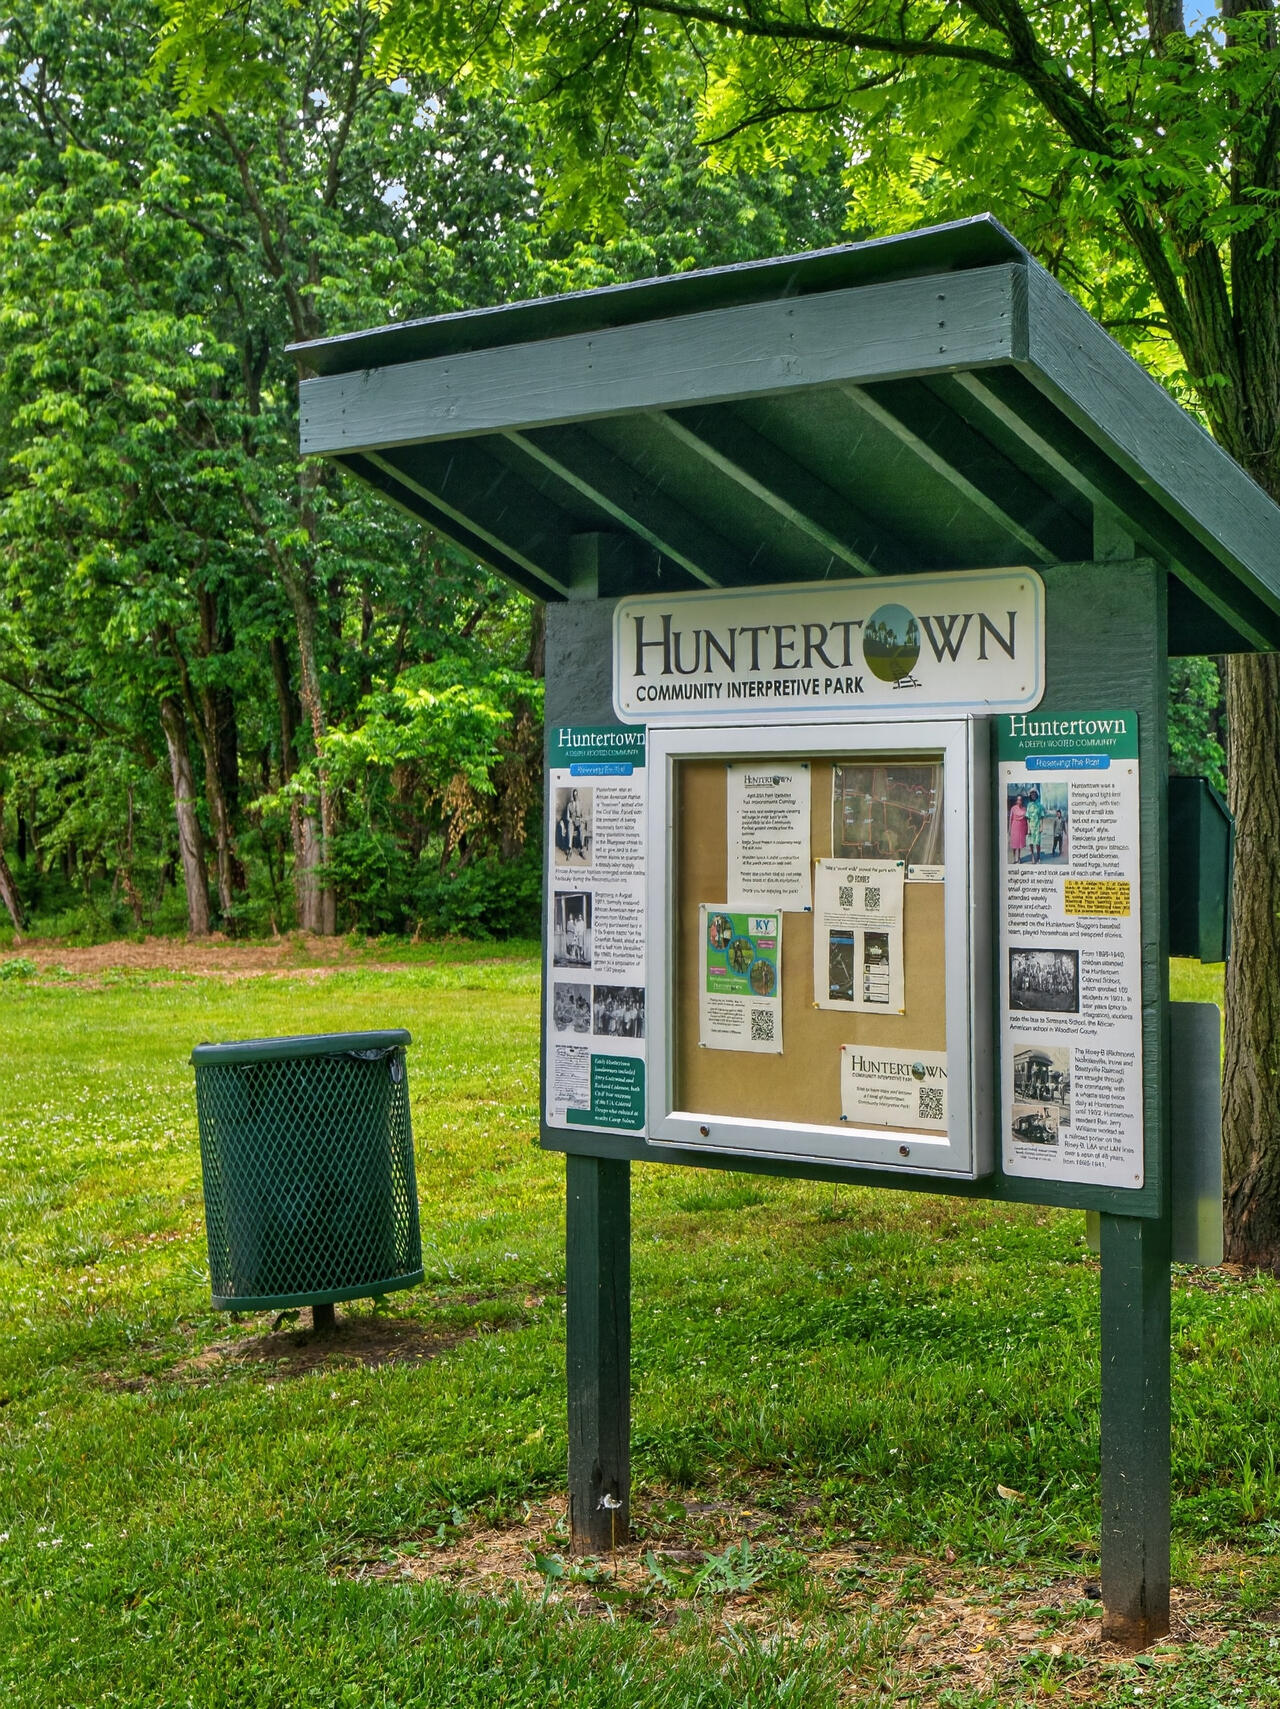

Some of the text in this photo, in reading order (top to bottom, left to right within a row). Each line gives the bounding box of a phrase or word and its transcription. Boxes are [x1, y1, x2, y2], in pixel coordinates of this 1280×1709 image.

[636, 676, 865, 702] COMMUNITY INTERPRETIVE PARK
[1009, 715, 1126, 736] Huntertown
[558, 728, 645, 747] Huntertown
